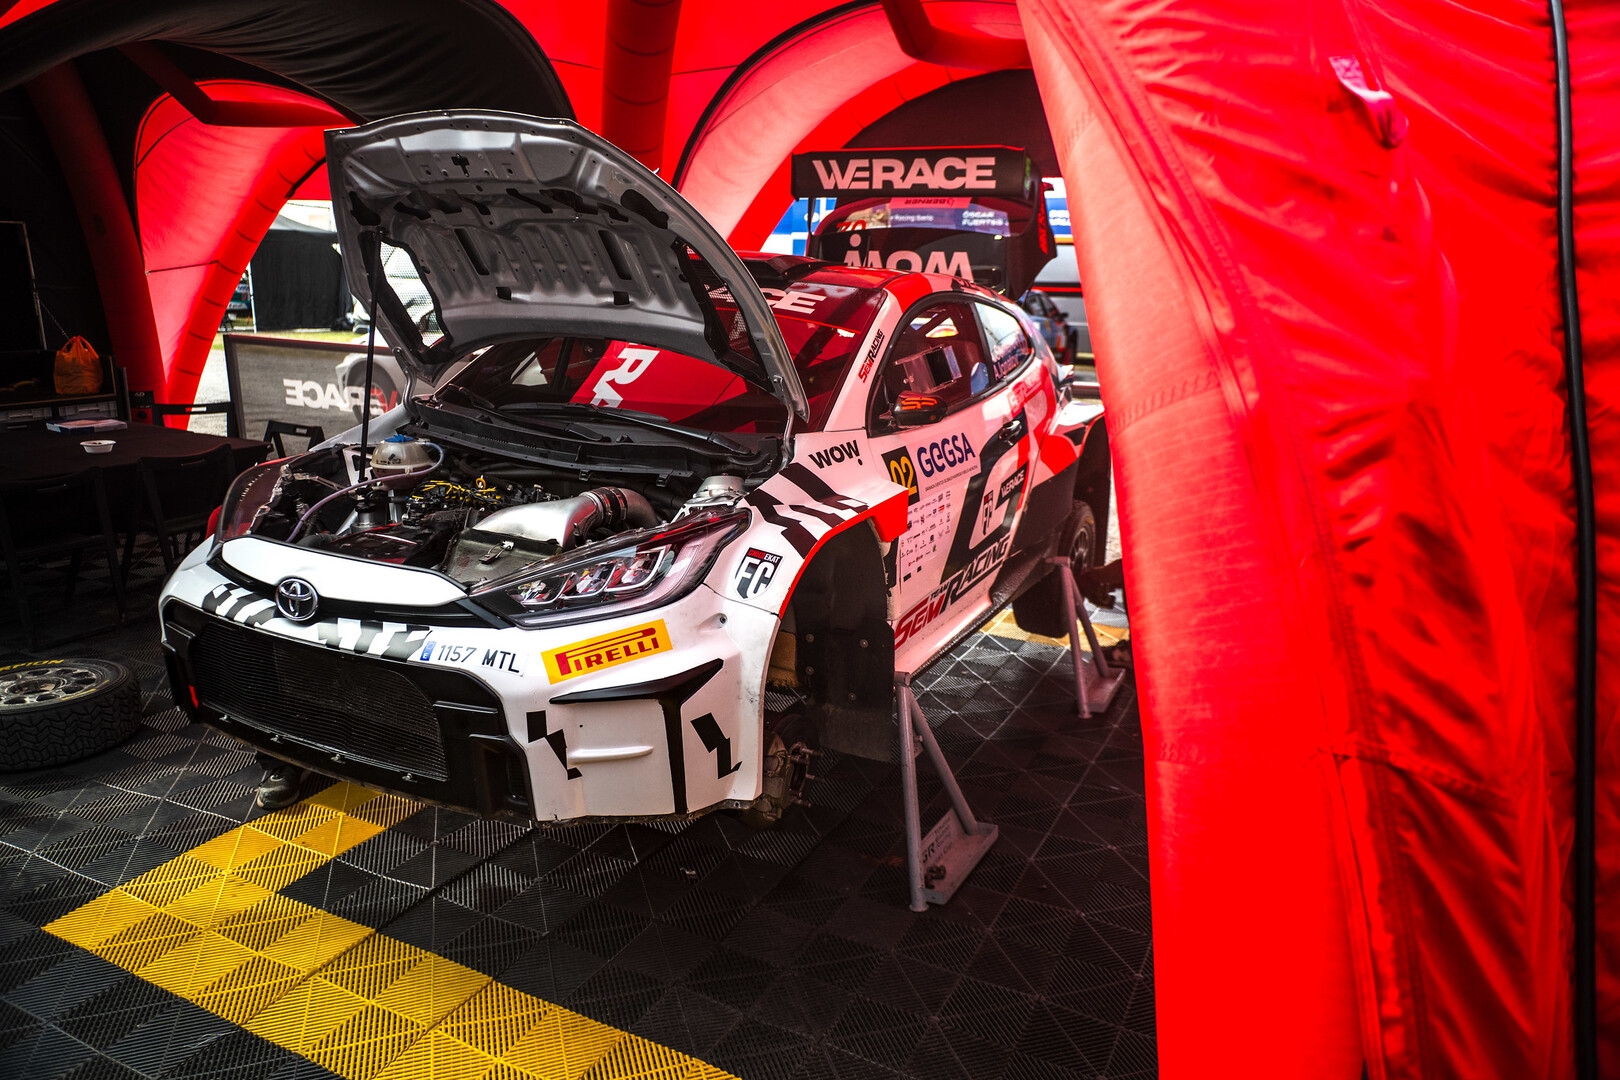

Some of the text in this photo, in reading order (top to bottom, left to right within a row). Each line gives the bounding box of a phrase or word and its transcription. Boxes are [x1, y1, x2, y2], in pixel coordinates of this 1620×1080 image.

[812, 156, 996, 190] WERACE
[437, 645, 477, 663] 1157
[481, 649, 520, 673] MTL
[555, 627, 659, 676] PIRELLI
